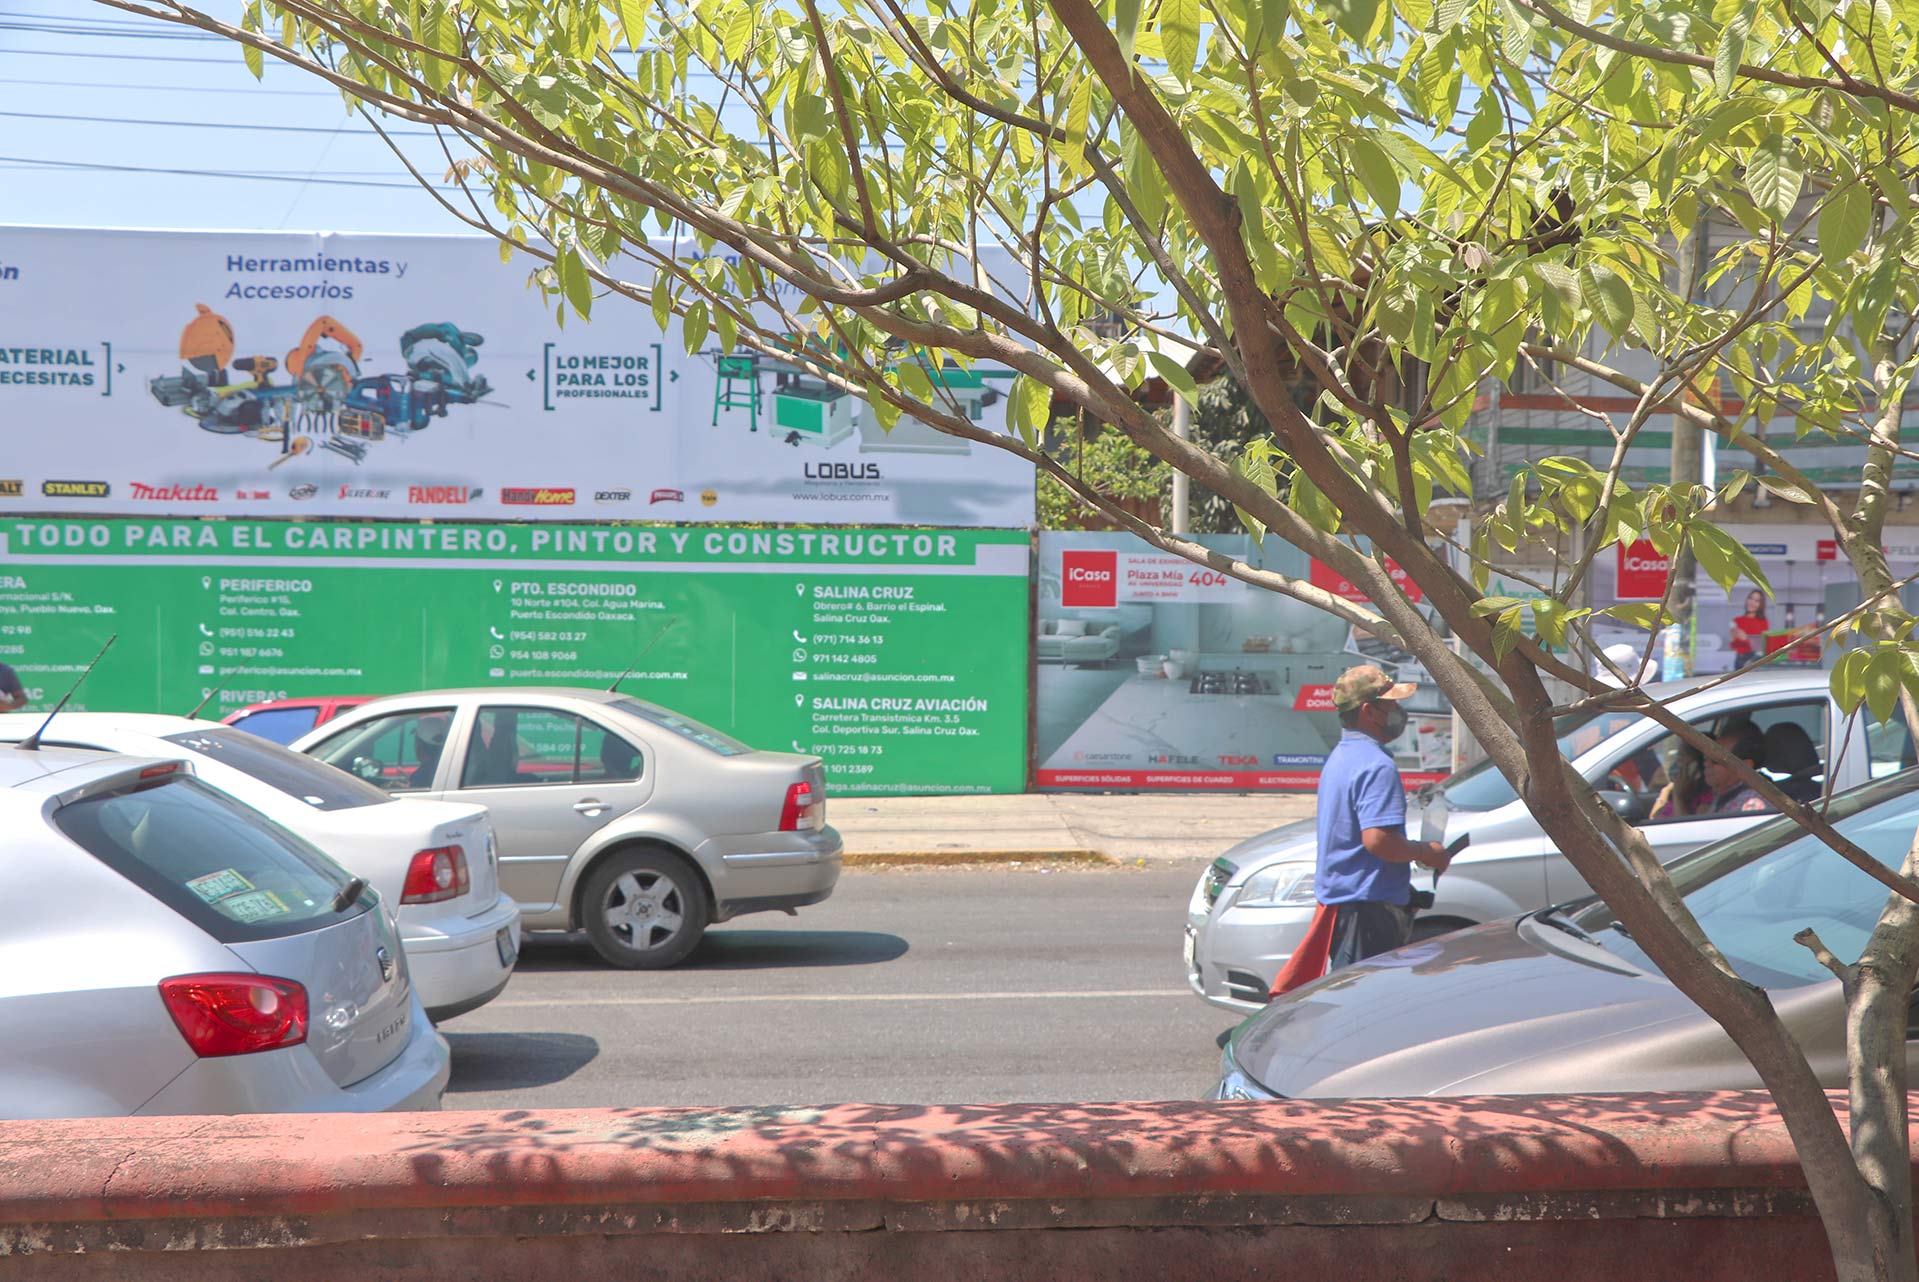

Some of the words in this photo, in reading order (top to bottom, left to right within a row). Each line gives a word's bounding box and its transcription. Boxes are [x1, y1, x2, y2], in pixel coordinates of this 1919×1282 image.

[227, 253, 390, 274] Herramientas
[396, 262, 408, 278] y
[225, 281, 353, 299] Accesorios
[556, 356, 579, 369] LO
[583, 356, 648, 370] MEJOR
[556, 373, 606, 386] PARA
[614, 373, 648, 386] LOS
[556, 390, 649, 398] PROFESIONALES
[805, 462, 880, 479] LOBUS
[45, 482, 107, 495] STANLEY
[409, 486, 467, 503] FANDELI
[595, 491, 631, 501] DEXTER
[793, 492, 890, 501] www.lobus.com.mx
[16, 524, 110, 547] TODO
[126, 525, 219, 548] PARA
[232, 526, 272, 548] EL
[285, 527, 517, 552] CARPINTERO,
[532, 530, 657, 554] PINTOR
[671, 532, 689, 554] Y
[704, 532, 957, 557] CONSTRUCTOR
[1069, 567, 1111, 581] iCasa
[1127, 570, 1159, 579] Plaza
[1188, 571, 1227, 586] 404
[220, 579, 312, 592] PERIFERICO
[511, 582, 544, 595] PTO.
[548, 582, 637, 596] ESCONDIDO
[813, 586, 869, 598] SALINA
[872, 586, 914, 599] CRUZ
[525, 598, 551, 607] Norte
[603, 600, 628, 610] Agua
[866, 602, 896, 611] Barrio
[898, 603, 907, 611] el
[511, 610, 543, 619] Puerto
[545, 610, 596, 620] Escondido
[813, 613, 843, 623] Salina
[845, 613, 868, 623] Cruz
[869, 613, 891, 623] Oax.
[812, 634, 837, 645] (971)
[812, 654, 829, 663] 971
[812, 672, 955, 683] salinacruz@asuncion.com.mx
[220, 689, 287, 702] RIVERAS
[812, 697, 868, 710] SALINA
[871, 698, 912, 711] CRUZ
[915, 696, 988, 712] AVIACIÓN
[812, 713, 860, 722] Carretera
[812, 725, 831, 734] Col.
[833, 725, 880, 736] Deportiva
[902, 726, 932, 736] Salina
[934, 726, 957, 736] Cruz
[958, 727, 980, 736] Oax.
